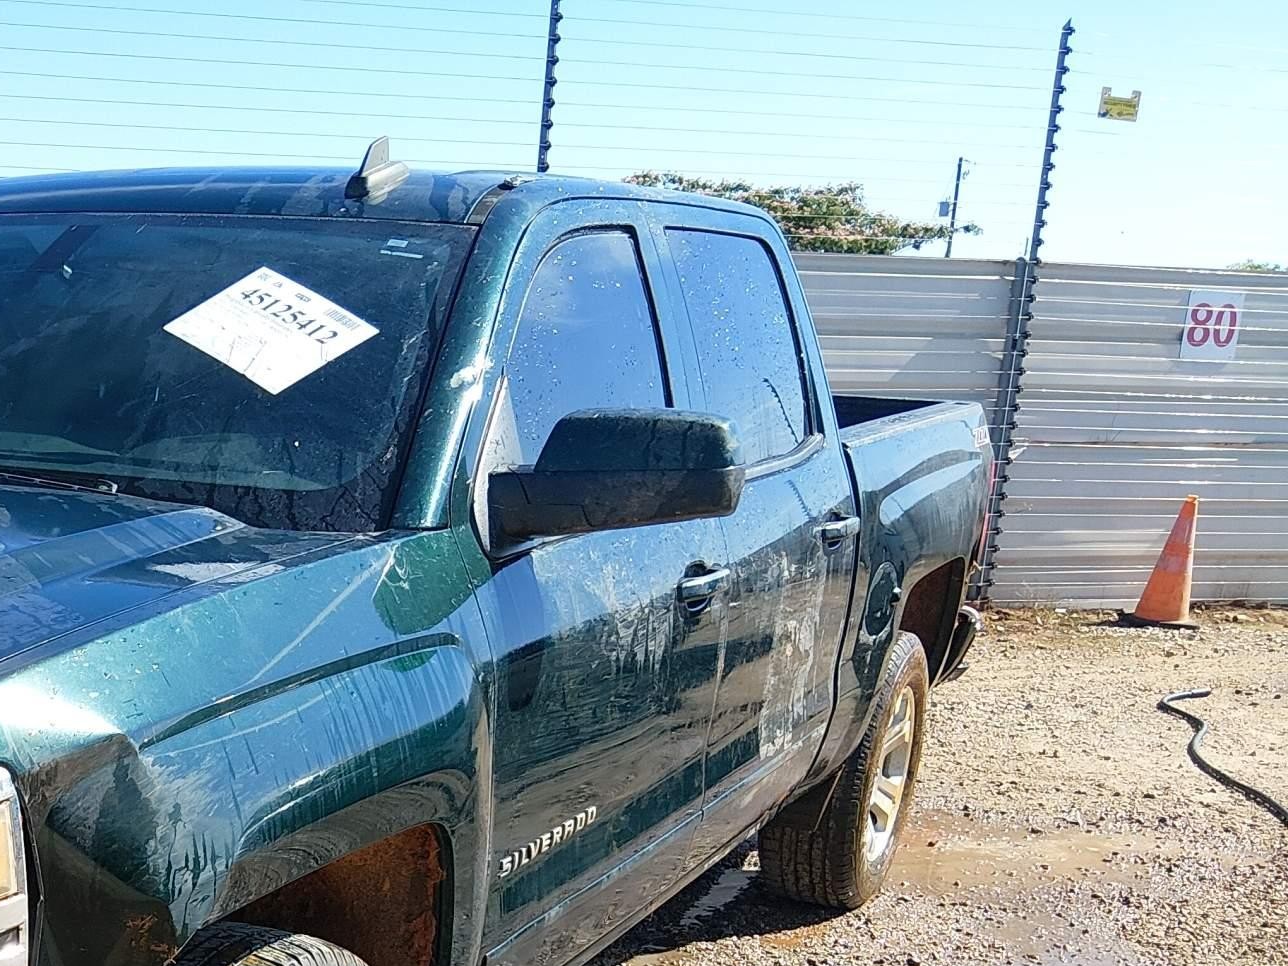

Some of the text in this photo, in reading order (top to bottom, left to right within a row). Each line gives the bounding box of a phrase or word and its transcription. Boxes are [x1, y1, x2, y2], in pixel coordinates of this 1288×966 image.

[240, 287, 338, 345] 45125412
[1186, 302, 1237, 348] 80
[497, 806, 597, 878] SILVERADO
